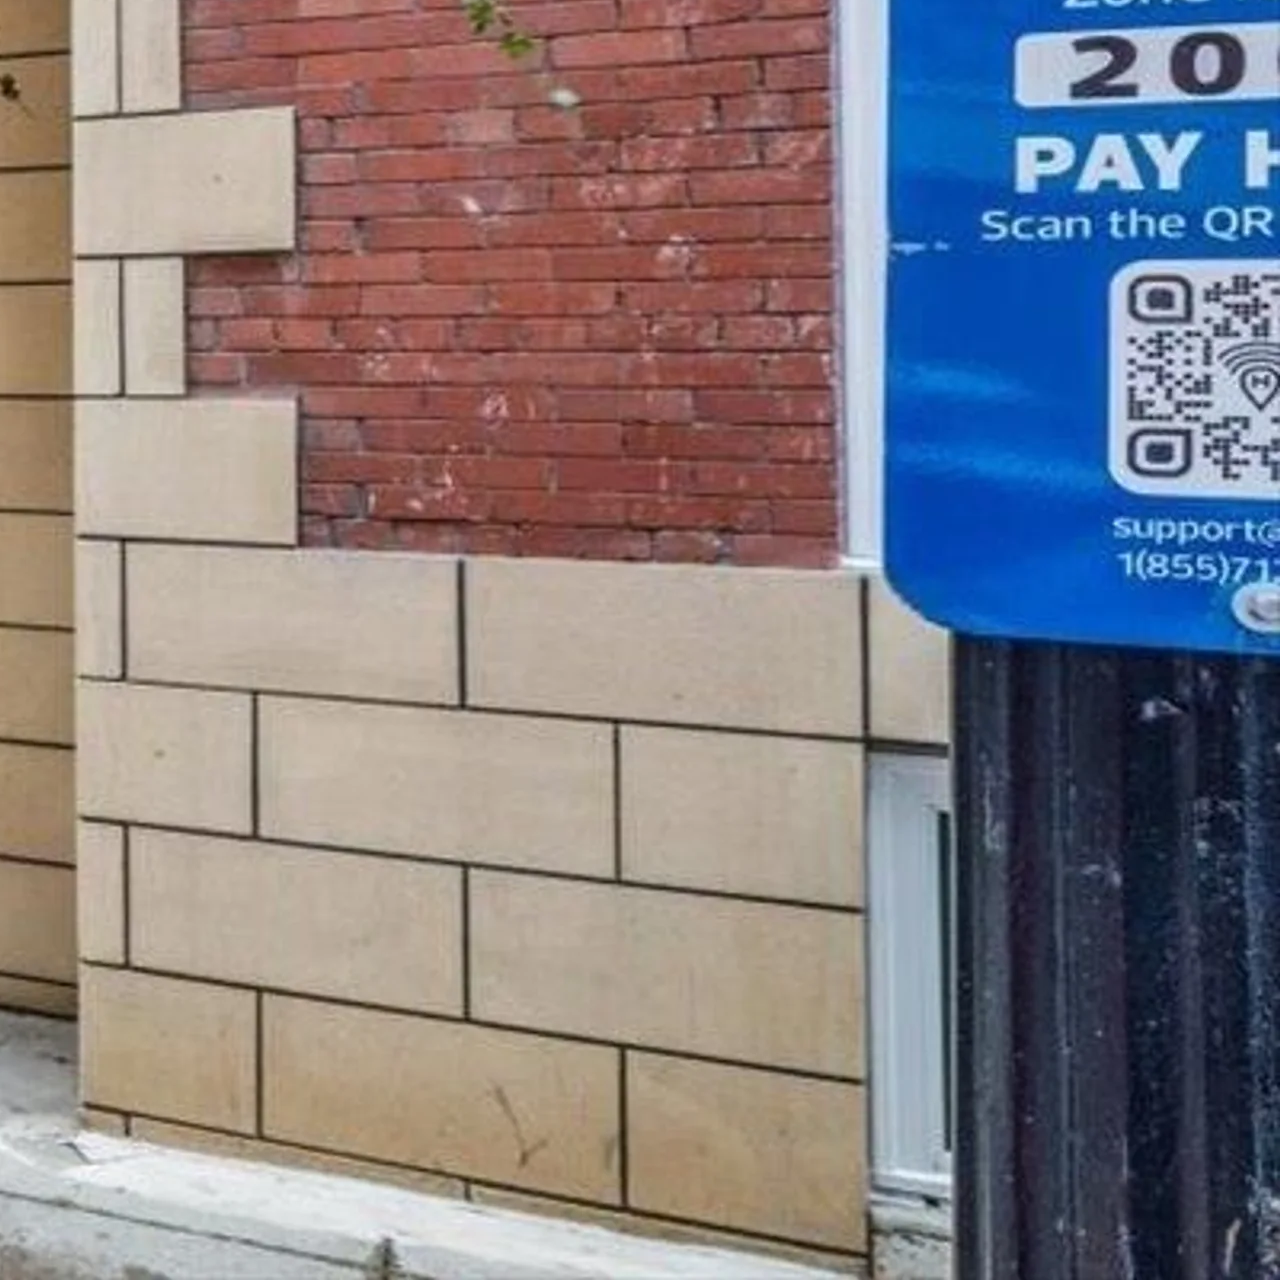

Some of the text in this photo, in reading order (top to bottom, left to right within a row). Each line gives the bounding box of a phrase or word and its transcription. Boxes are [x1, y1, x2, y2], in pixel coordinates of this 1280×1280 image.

[1069, 31, 1280, 99] 20
[1014, 131, 1203, 193] PAY
[981, 205, 1274, 242] Scan the QR
[1117, 548, 1280, 586] 1(855)71
